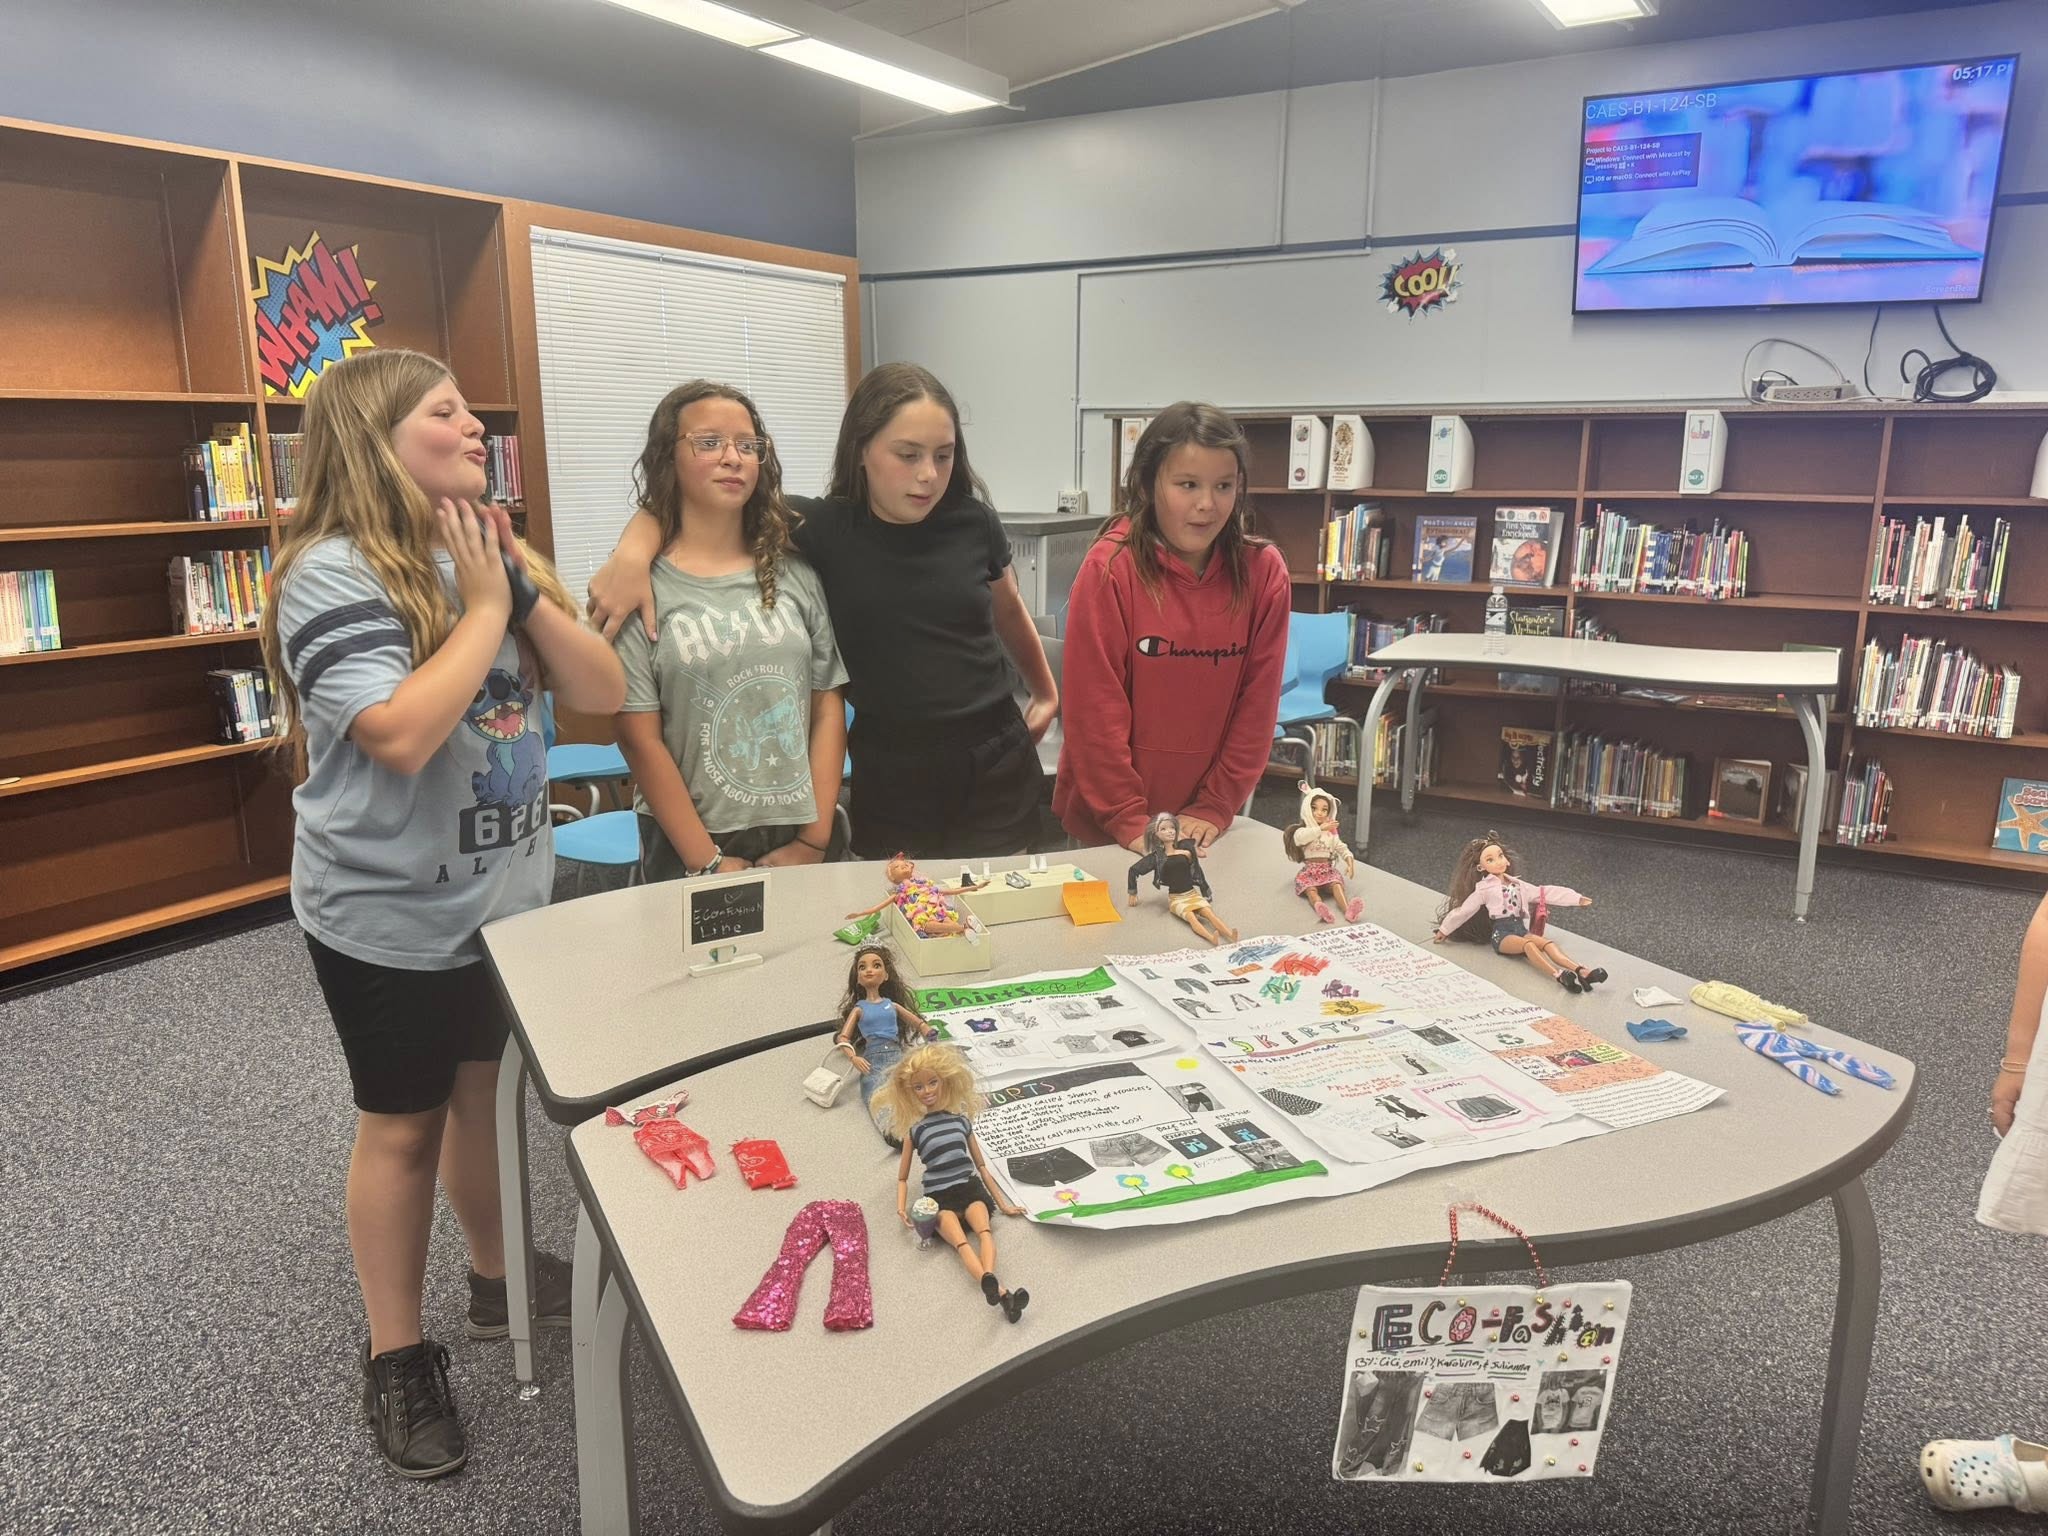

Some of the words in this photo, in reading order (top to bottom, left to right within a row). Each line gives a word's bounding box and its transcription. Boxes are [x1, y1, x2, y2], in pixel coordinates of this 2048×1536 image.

[1953, 65, 1993, 80] 05:17
[1585, 93, 1717, 119] CAES-B1-124-SB
[1394, 265, 1459, 296] COOL!
[256, 239, 383, 389] WHAM!
[1136, 635, 1248, 667] Champio
[726, 666, 754, 689] ROCK
[700, 722, 711, 747] FOR
[703, 749, 723, 787] THOSE
[1532, 745, 1545, 787] ectricity
[721, 782, 759, 806] ABOUT
[761, 794, 777, 807] TO
[926, 986, 1031, 1009] Shirts
